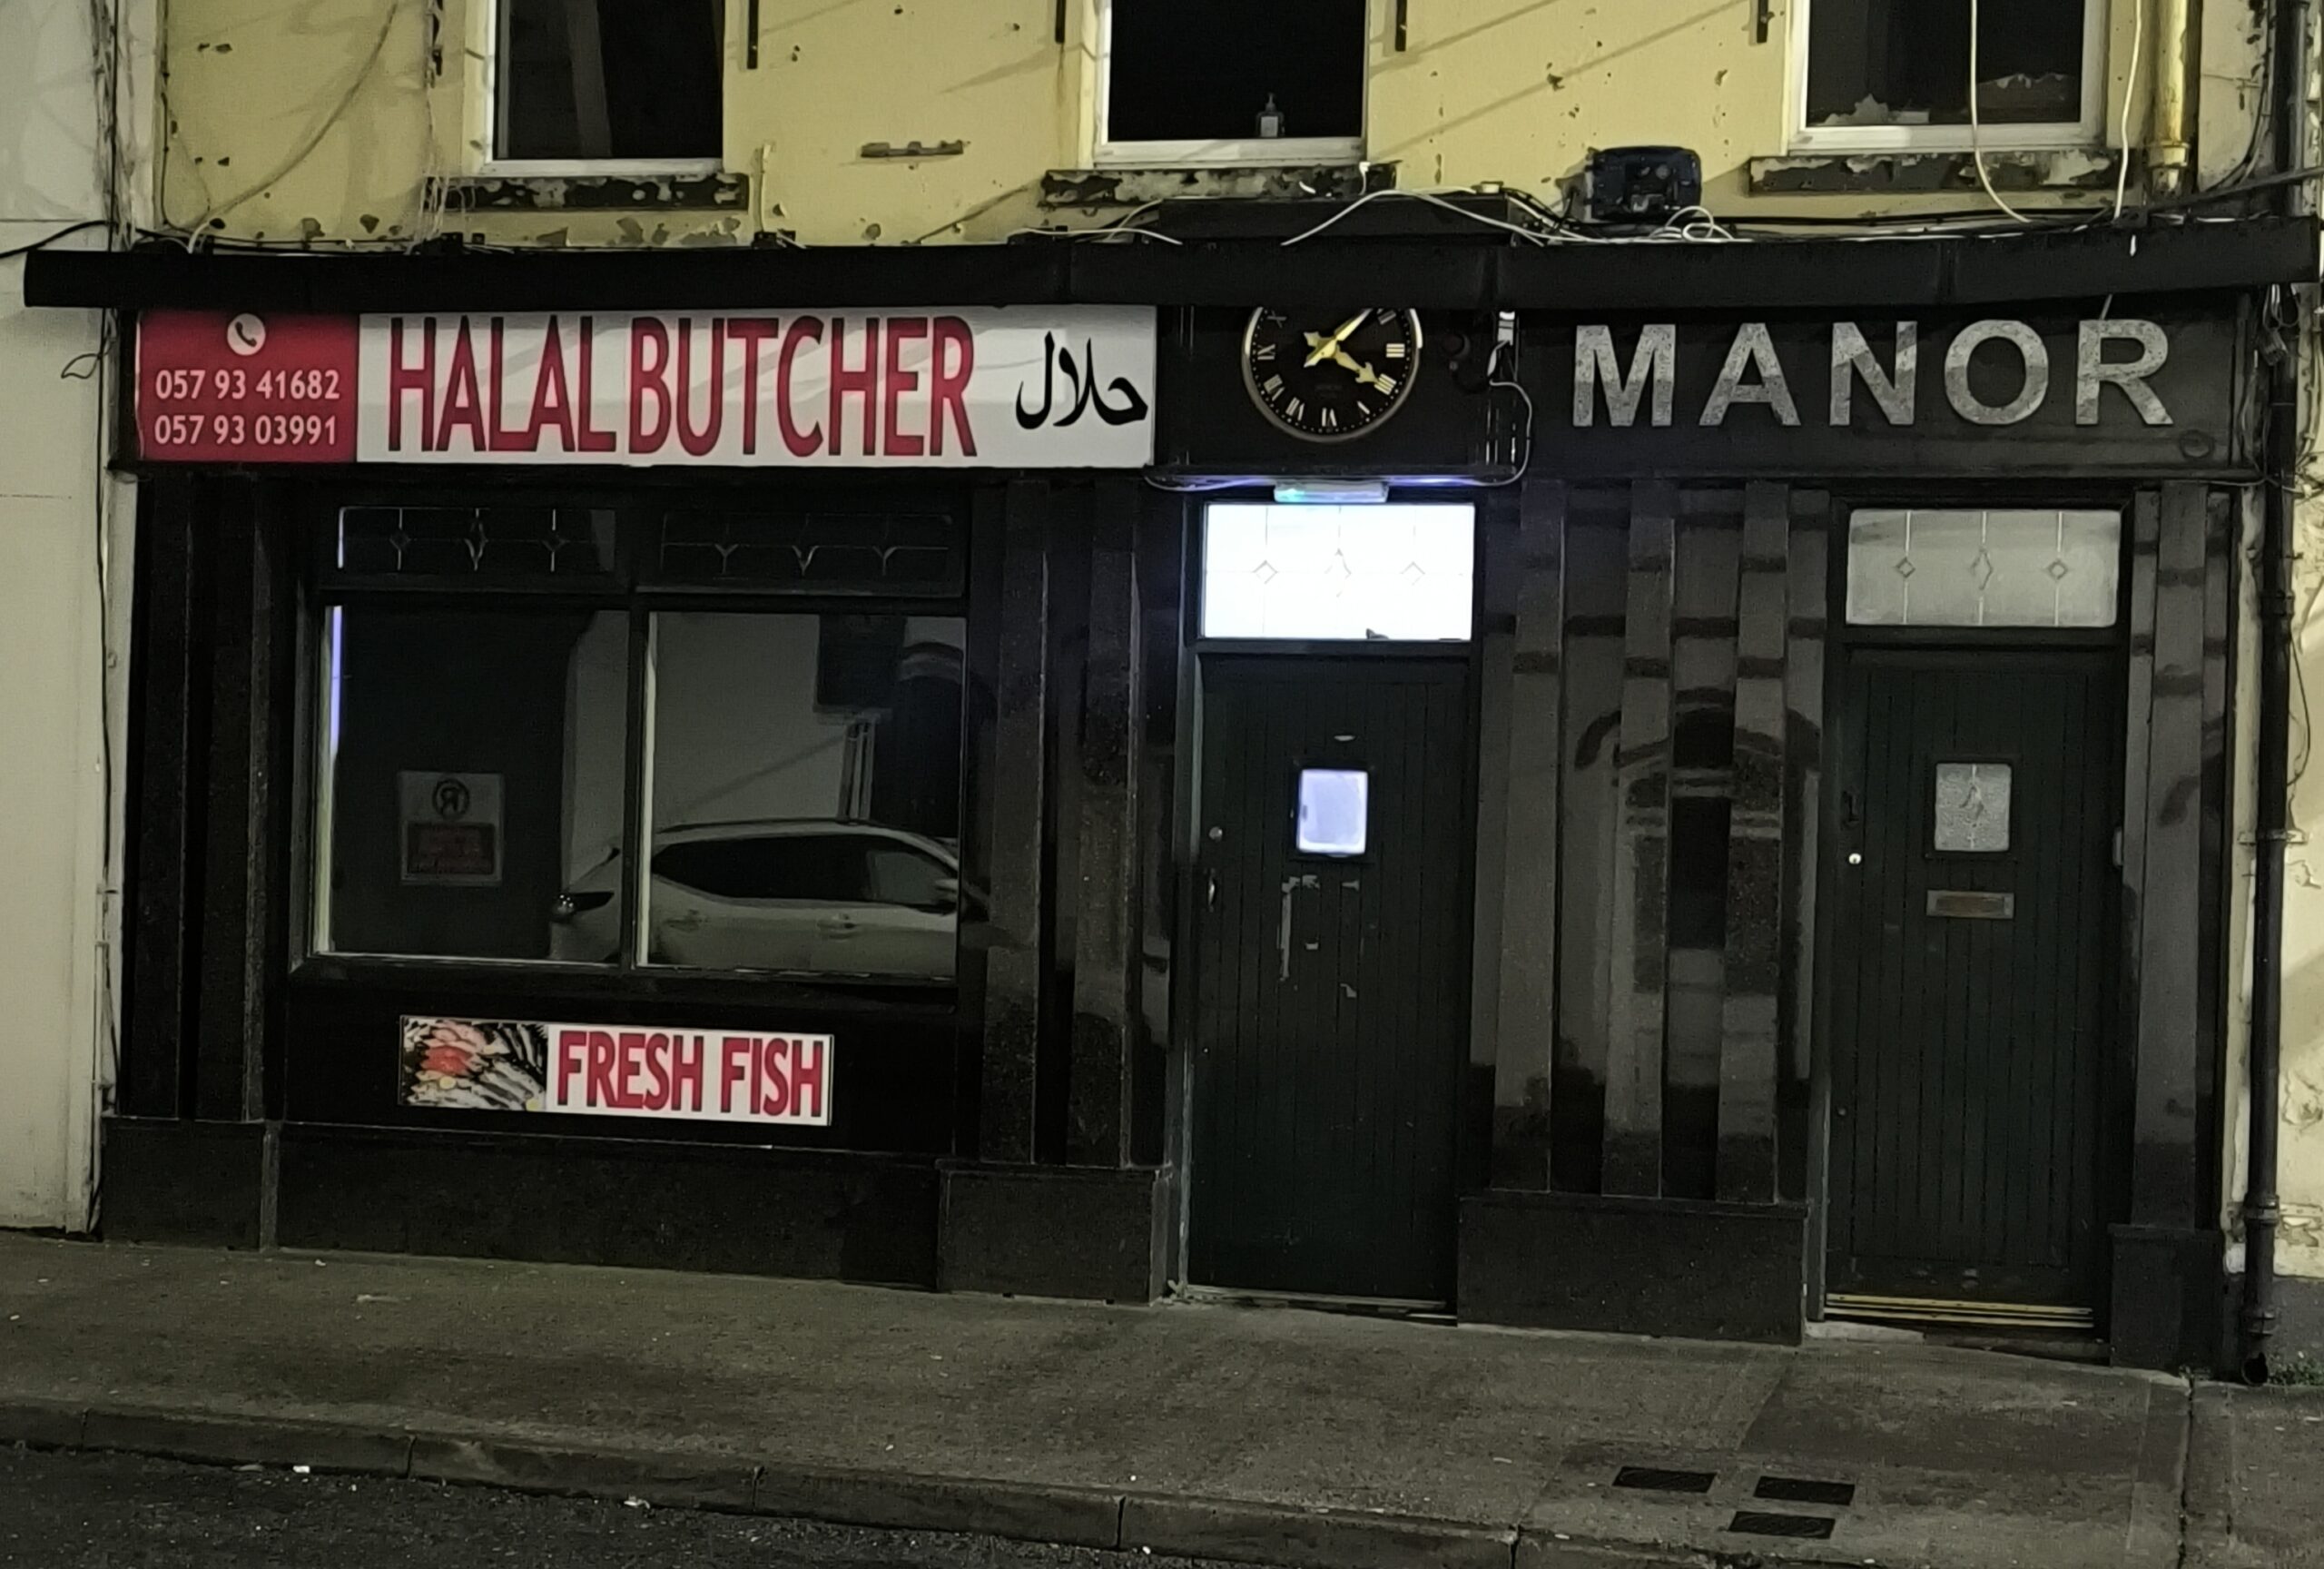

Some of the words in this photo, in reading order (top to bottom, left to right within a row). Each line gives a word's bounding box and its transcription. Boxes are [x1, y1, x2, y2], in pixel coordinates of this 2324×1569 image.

[156, 370, 205, 400] 057
[214, 370, 246, 400] 93
[255, 370, 340, 400] 41682
[389, 314, 617, 452] HALAL
[628, 314, 978, 457] BUTCHER
[1016, 330, 1148, 430] حلال
[1385, 343, 1405, 358] III
[1571, 319, 2174, 428] MANOR
[154, 415, 203, 445] 057
[213, 415, 245, 445] 93
[254, 415, 337, 446] 03991
[556, 1030, 705, 1112] FRESH
[720, 1035, 824, 1118] FISH
